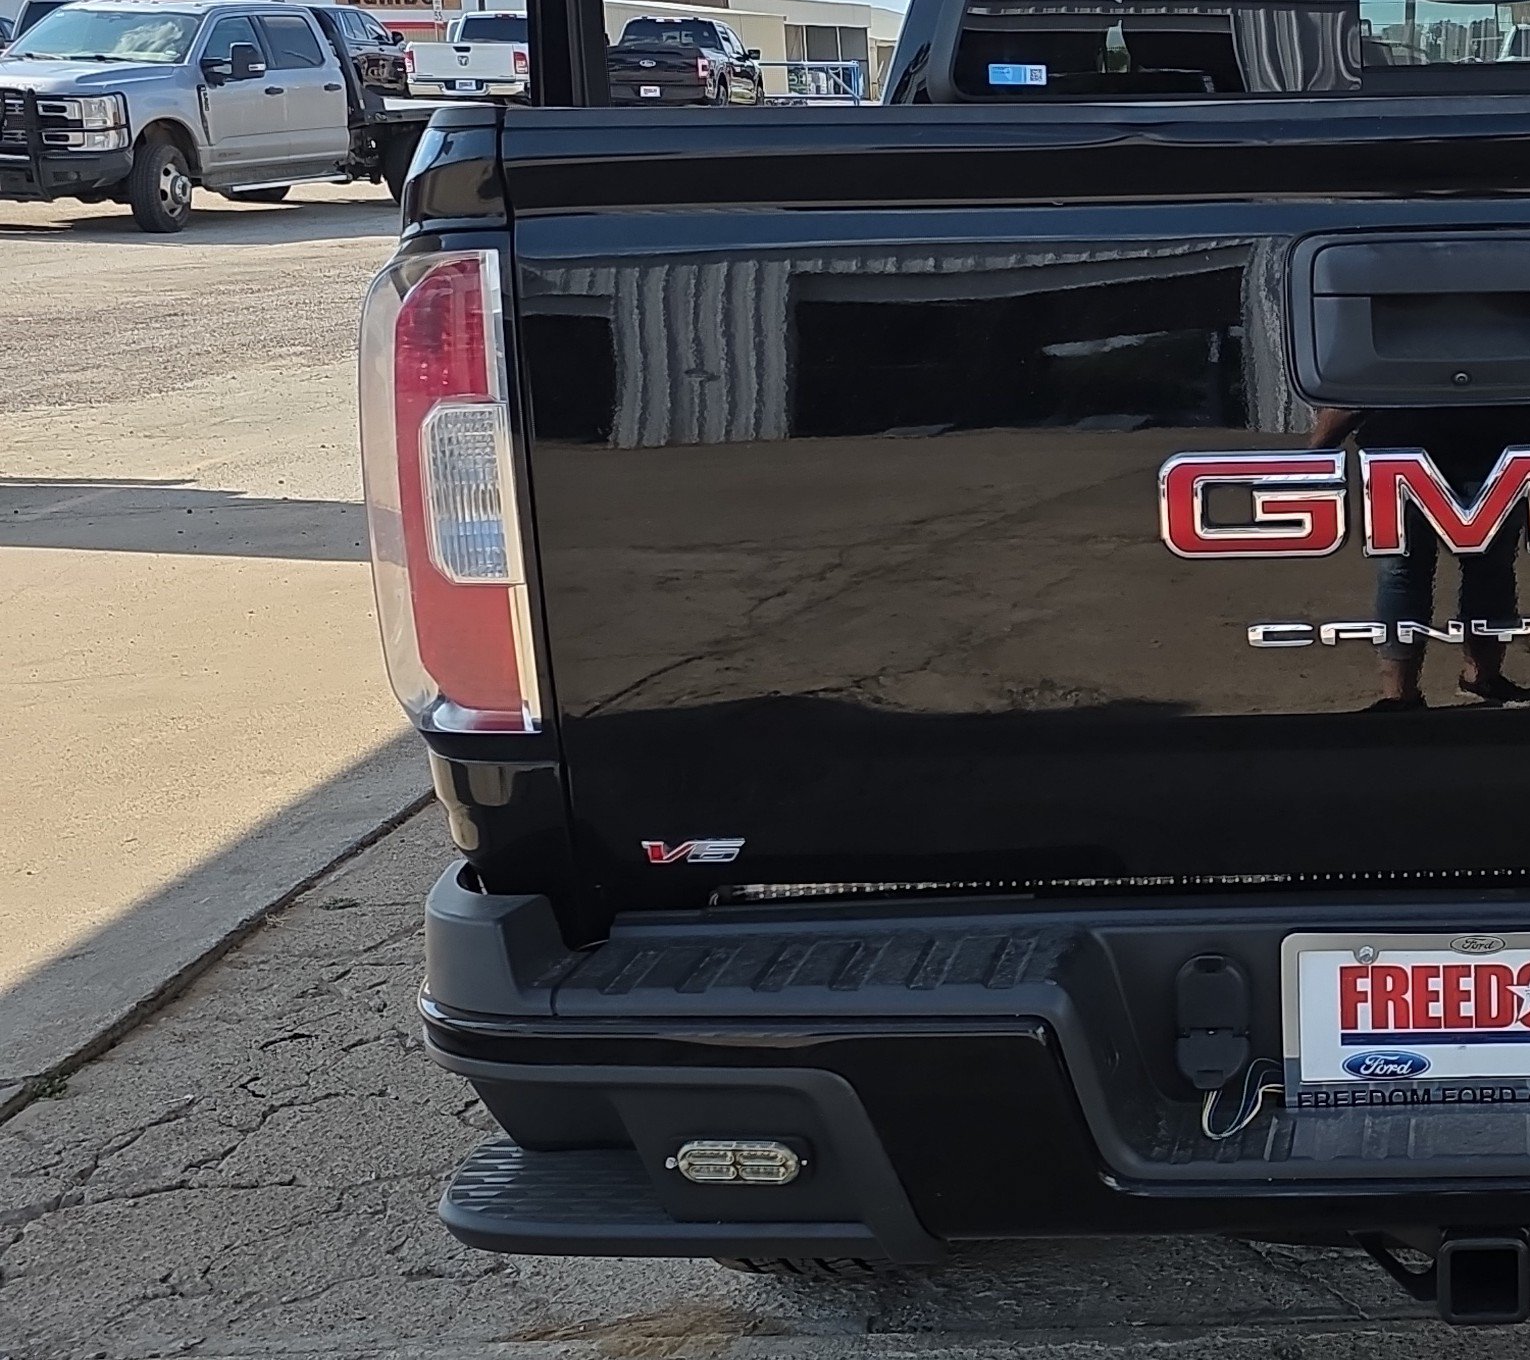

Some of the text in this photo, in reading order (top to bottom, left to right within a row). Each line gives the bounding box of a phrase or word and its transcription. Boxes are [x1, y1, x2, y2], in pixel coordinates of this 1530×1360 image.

[641, 838, 746, 863] V6
[1461, 938, 1496, 951] Ford
[1358, 1054, 1413, 1076] Ford
[1297, 1088, 1431, 1108] FREEDOM
